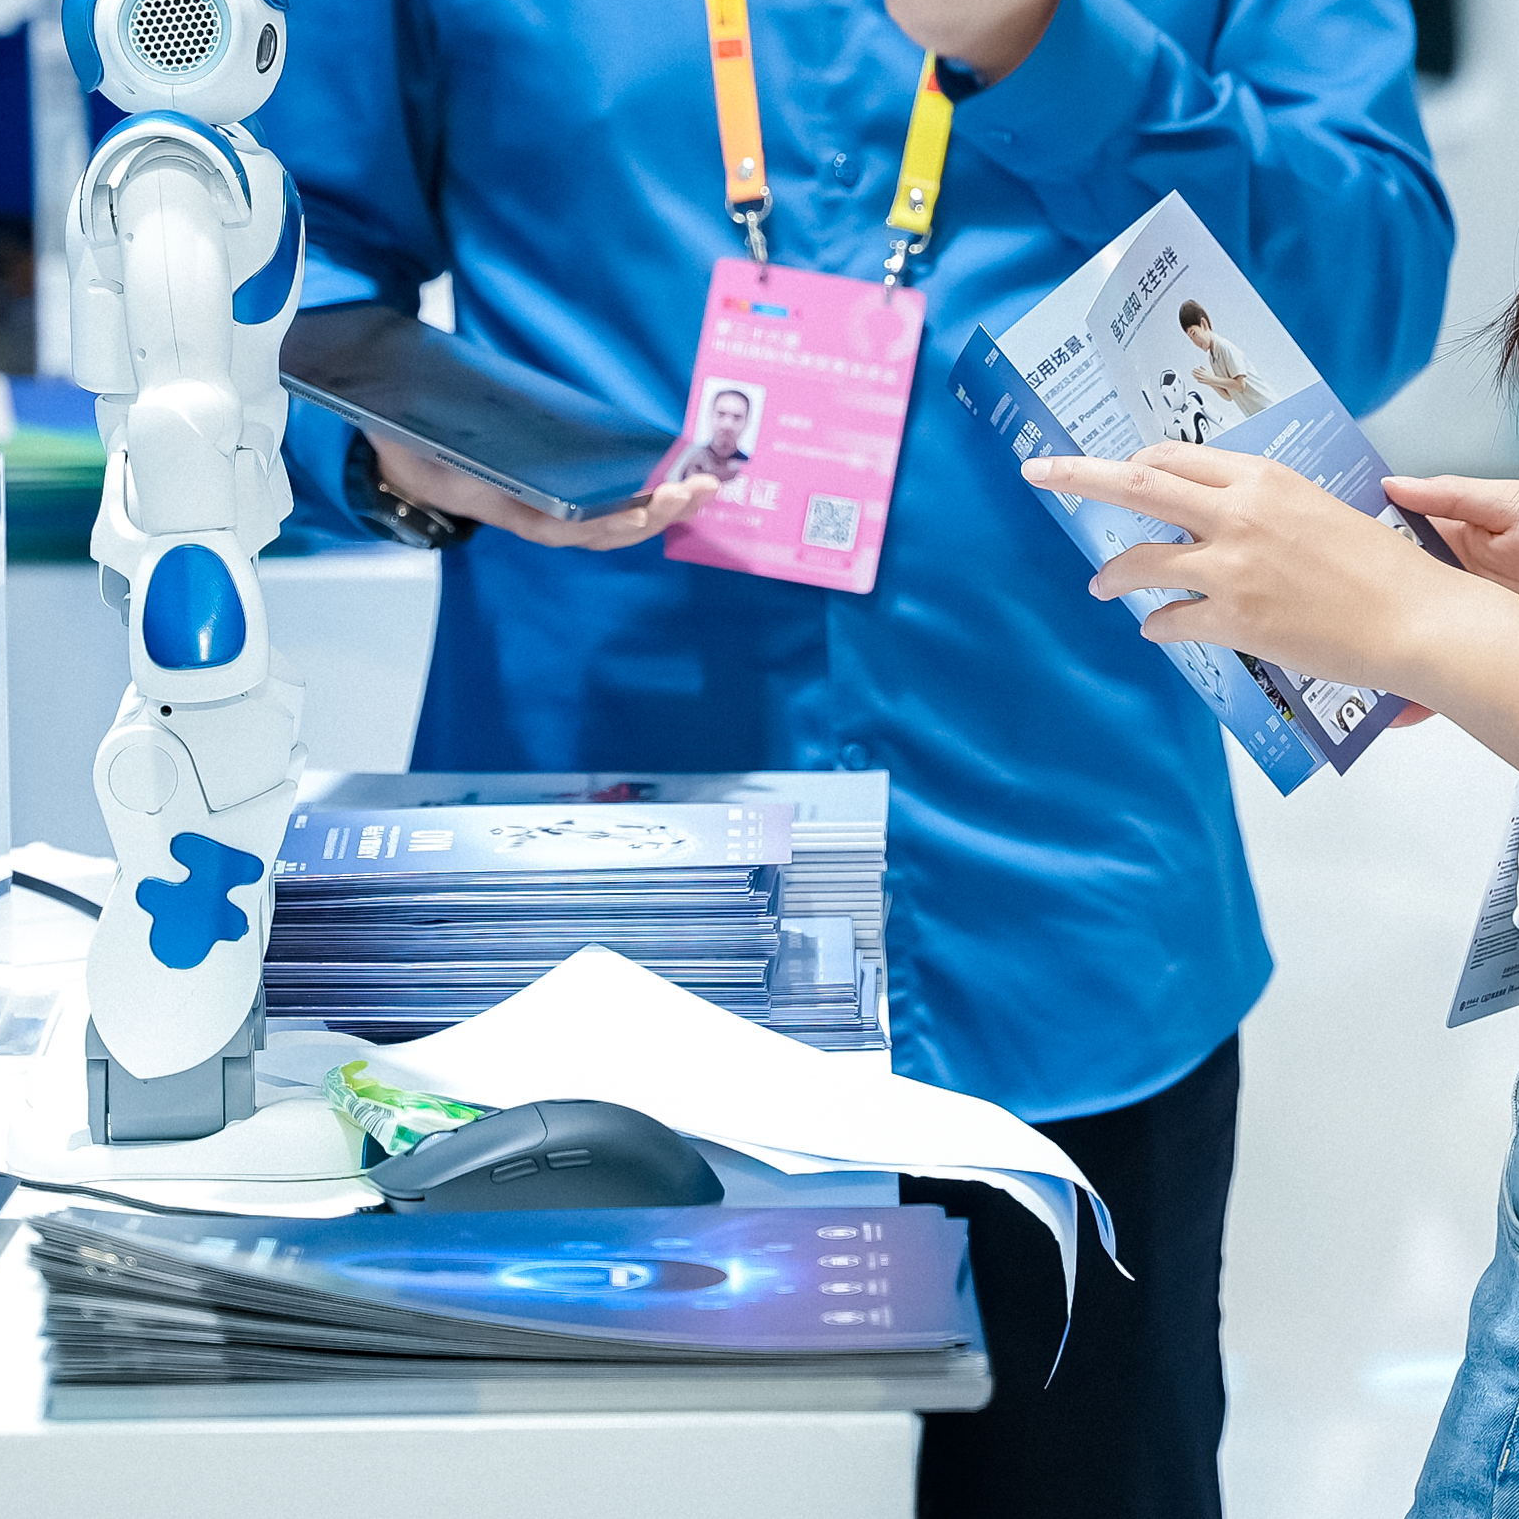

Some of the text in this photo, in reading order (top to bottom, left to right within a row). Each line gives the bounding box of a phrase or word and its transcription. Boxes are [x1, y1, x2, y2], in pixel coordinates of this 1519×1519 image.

[1110, 291, 1143, 344] 强大感知
[1138, 245, 1179, 301] 天生学伴
[1079, 389, 1119, 424] Powering
[407, 829, 455, 853] NAO
